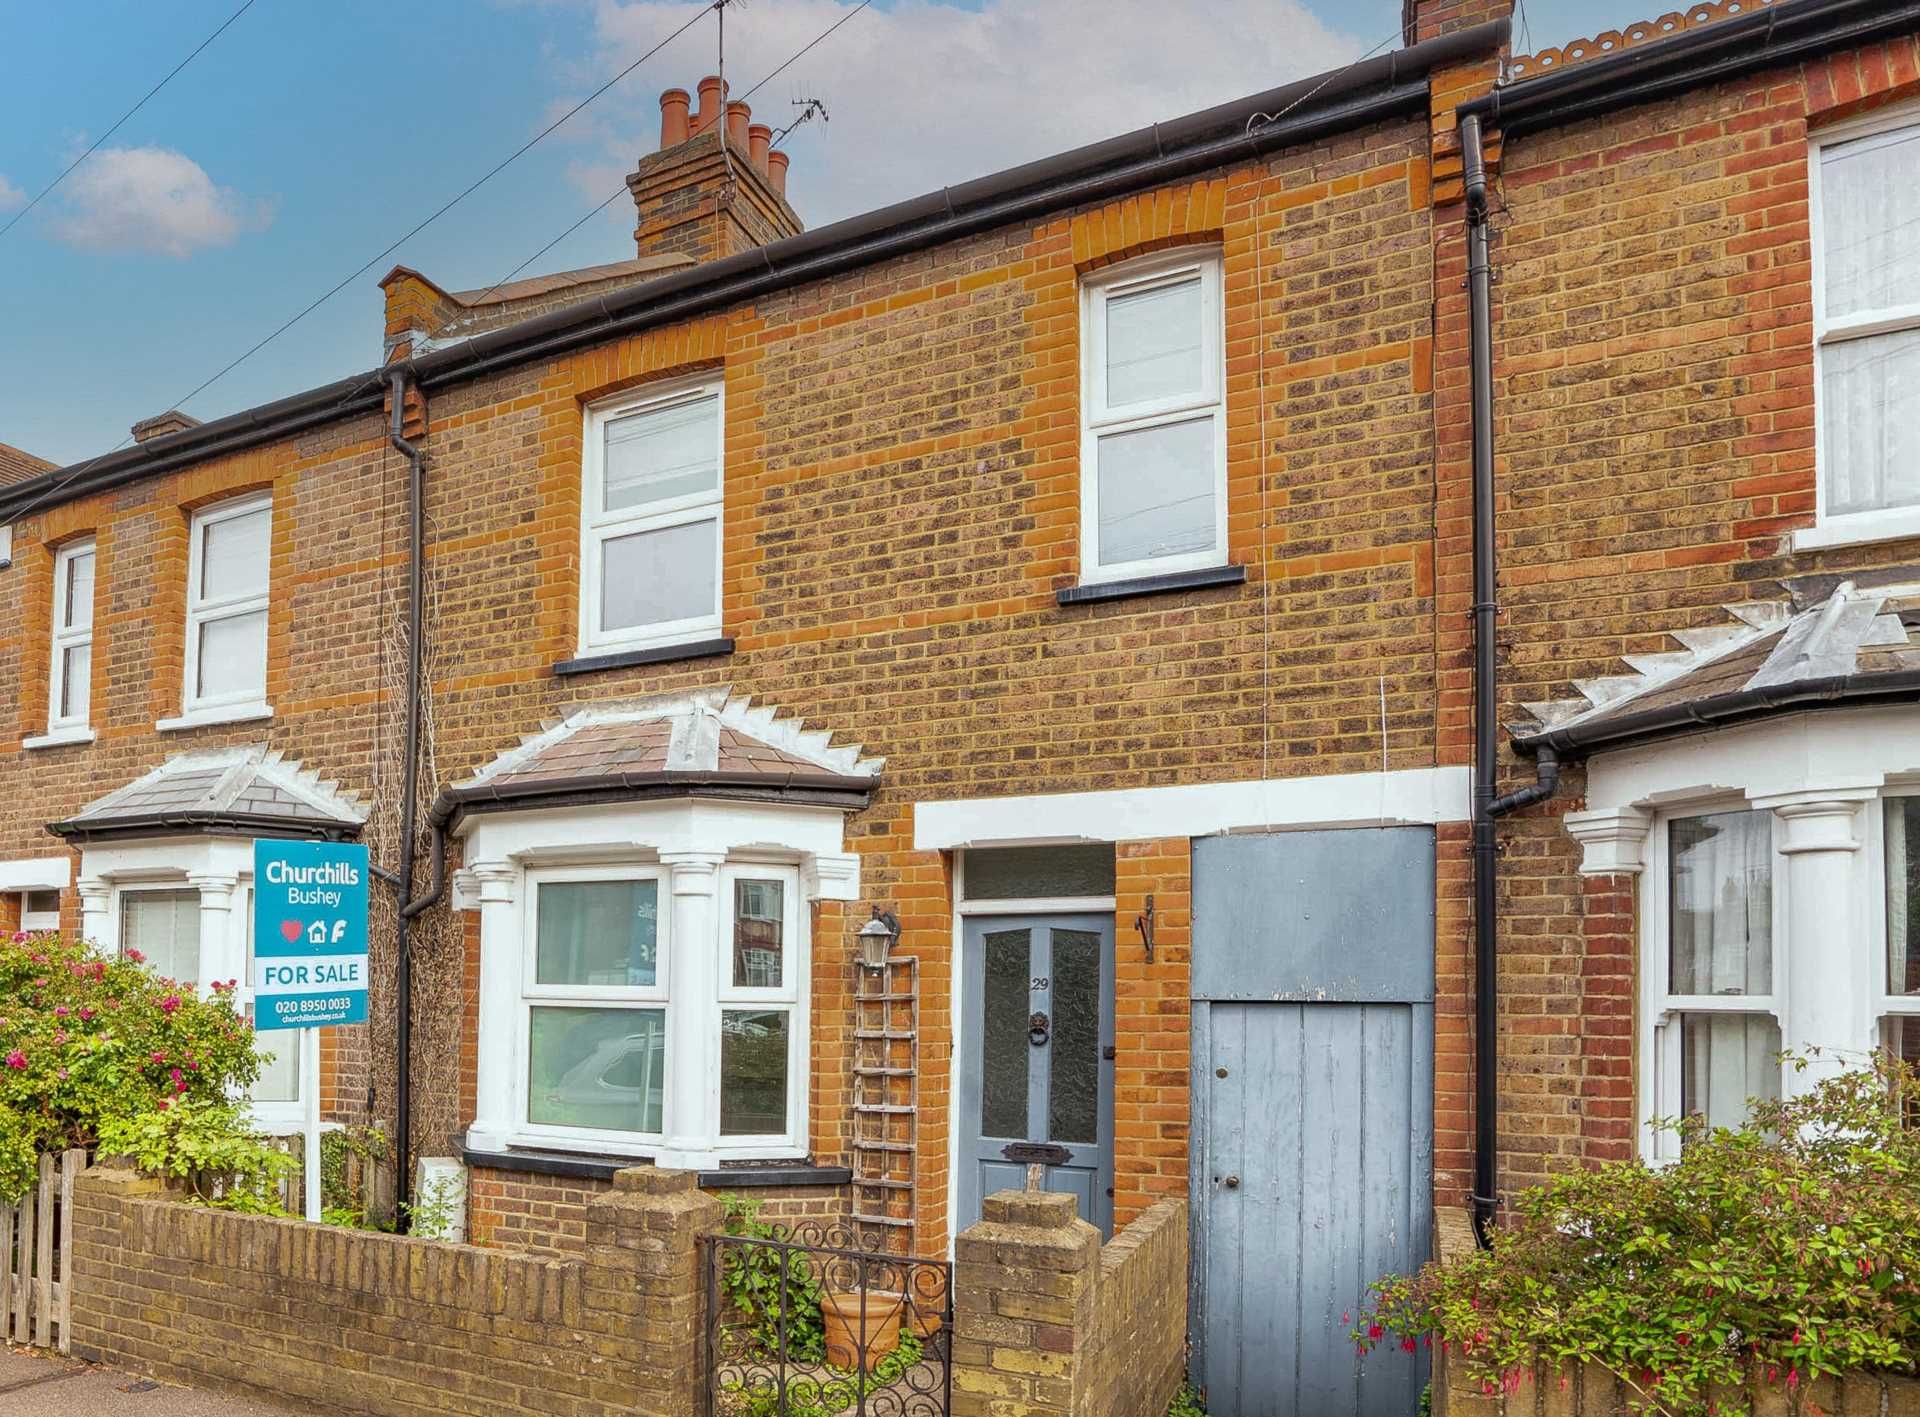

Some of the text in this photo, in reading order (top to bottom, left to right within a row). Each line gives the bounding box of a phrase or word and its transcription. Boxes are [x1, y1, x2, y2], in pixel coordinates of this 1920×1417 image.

[266, 860, 359, 885] Churchills
[288, 887, 341, 908] Bushey
[265, 963, 359, 985] FOR SALE
[1030, 977, 1049, 991] 29
[275, 997, 351, 1014] 020 8950 0033
